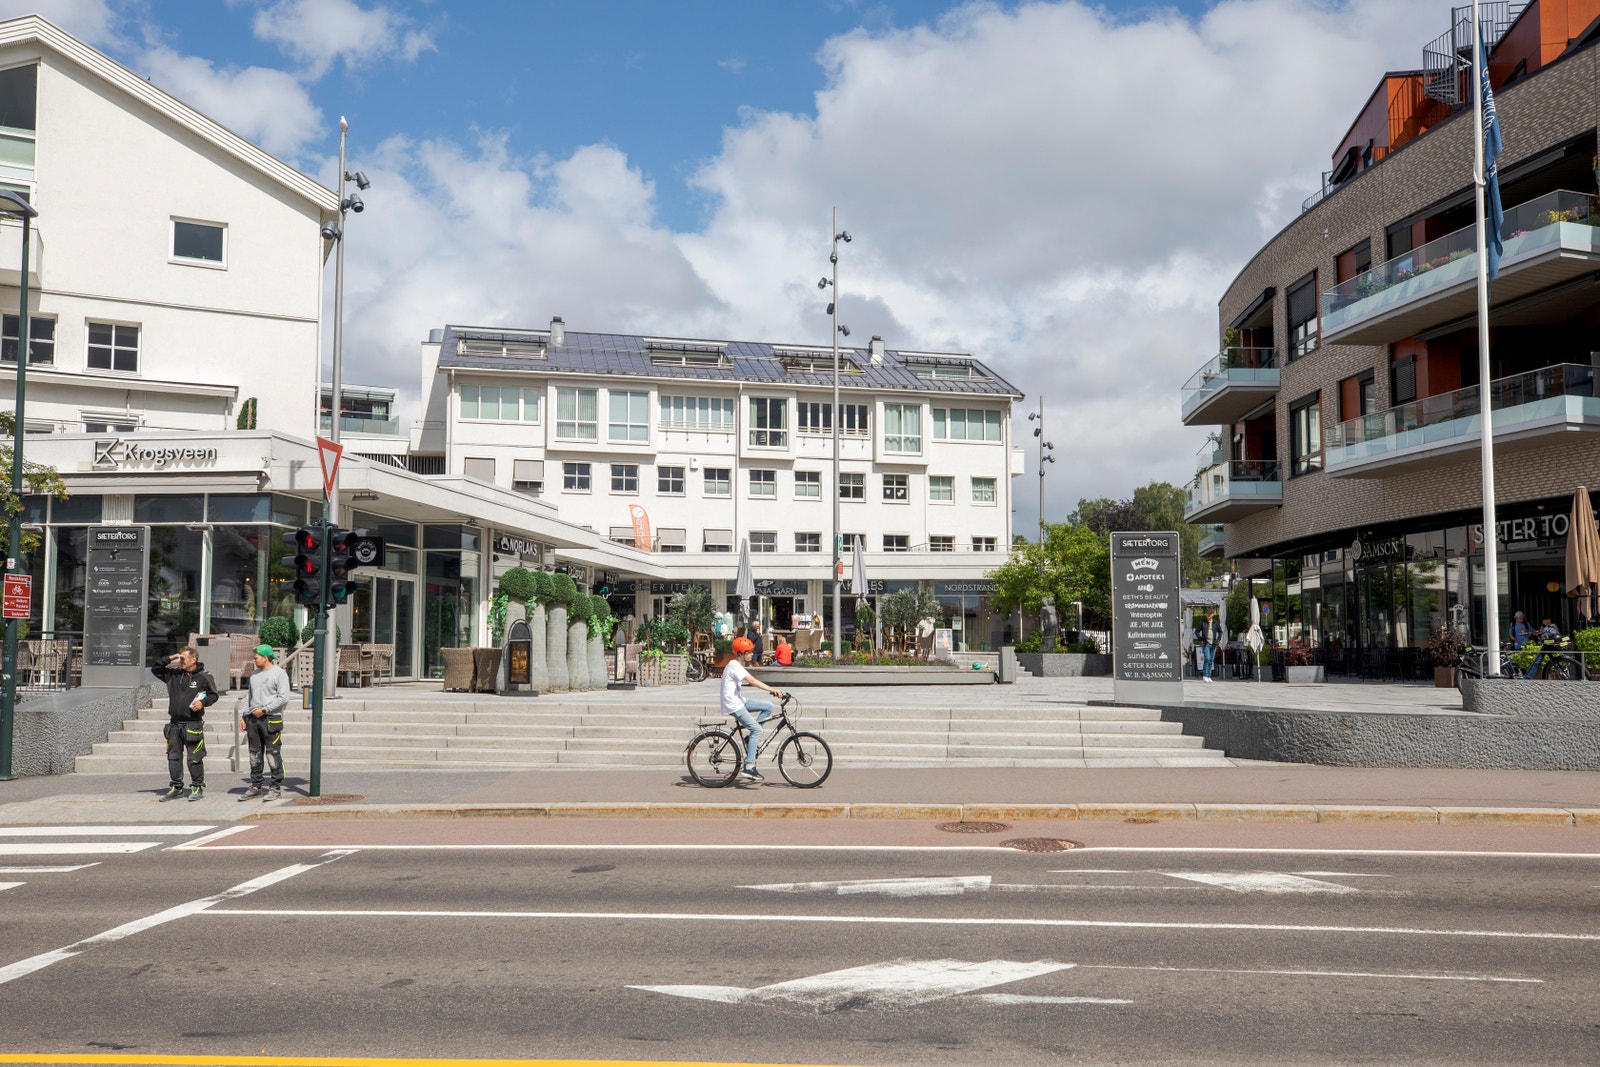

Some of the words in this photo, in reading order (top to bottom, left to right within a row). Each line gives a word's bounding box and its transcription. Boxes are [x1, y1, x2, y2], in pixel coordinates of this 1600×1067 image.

[123, 444, 217, 466] Krogsveen
[1474, 518, 1538, 544] STER
[510, 538, 537, 556] NORLAKS
